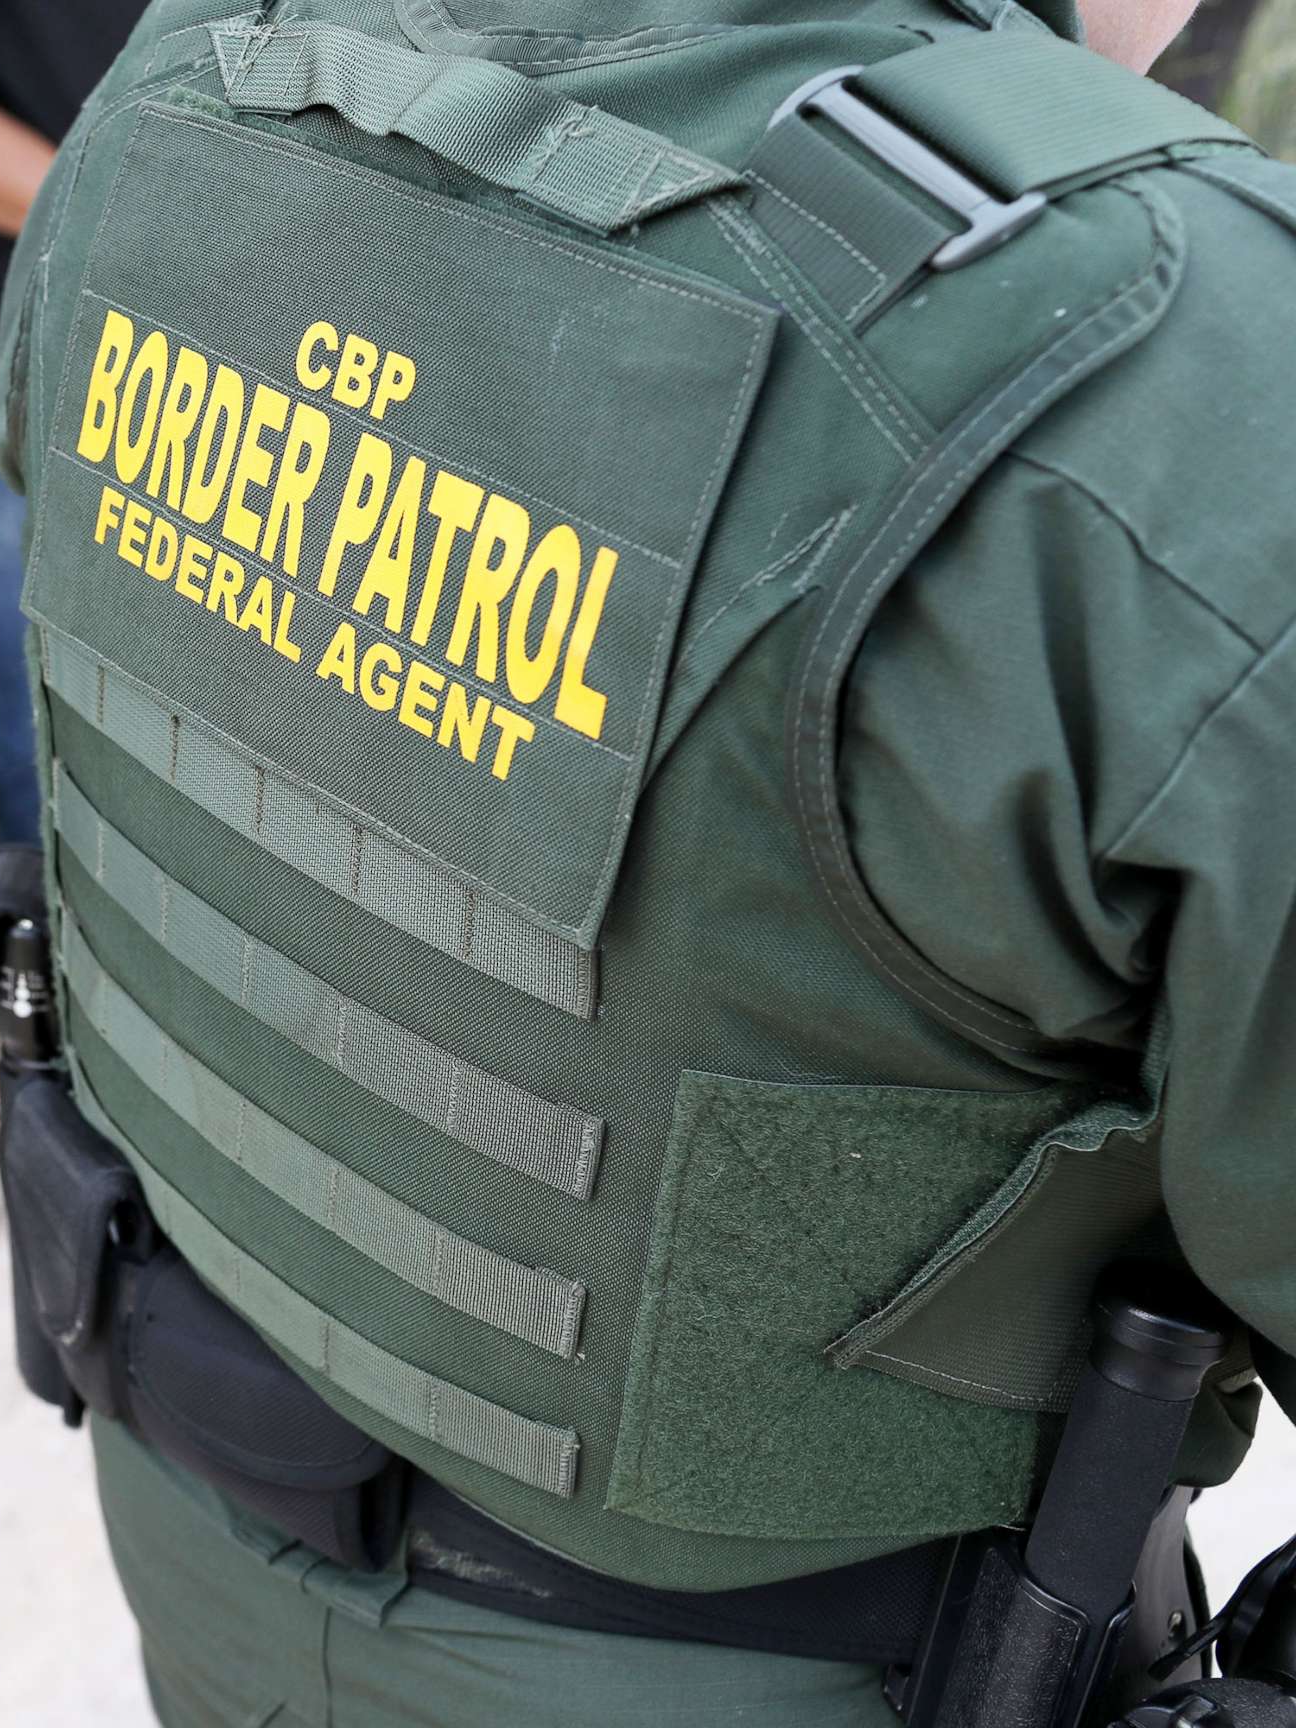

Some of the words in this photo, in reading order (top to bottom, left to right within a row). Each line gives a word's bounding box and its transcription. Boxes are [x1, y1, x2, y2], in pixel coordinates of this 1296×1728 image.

[296, 320, 416, 419] CBP
[77, 310, 331, 577] BORDER
[317, 432, 619, 741] PATROL
[93, 486, 302, 664] FEDERAL
[315, 621, 535, 782] AGENT
